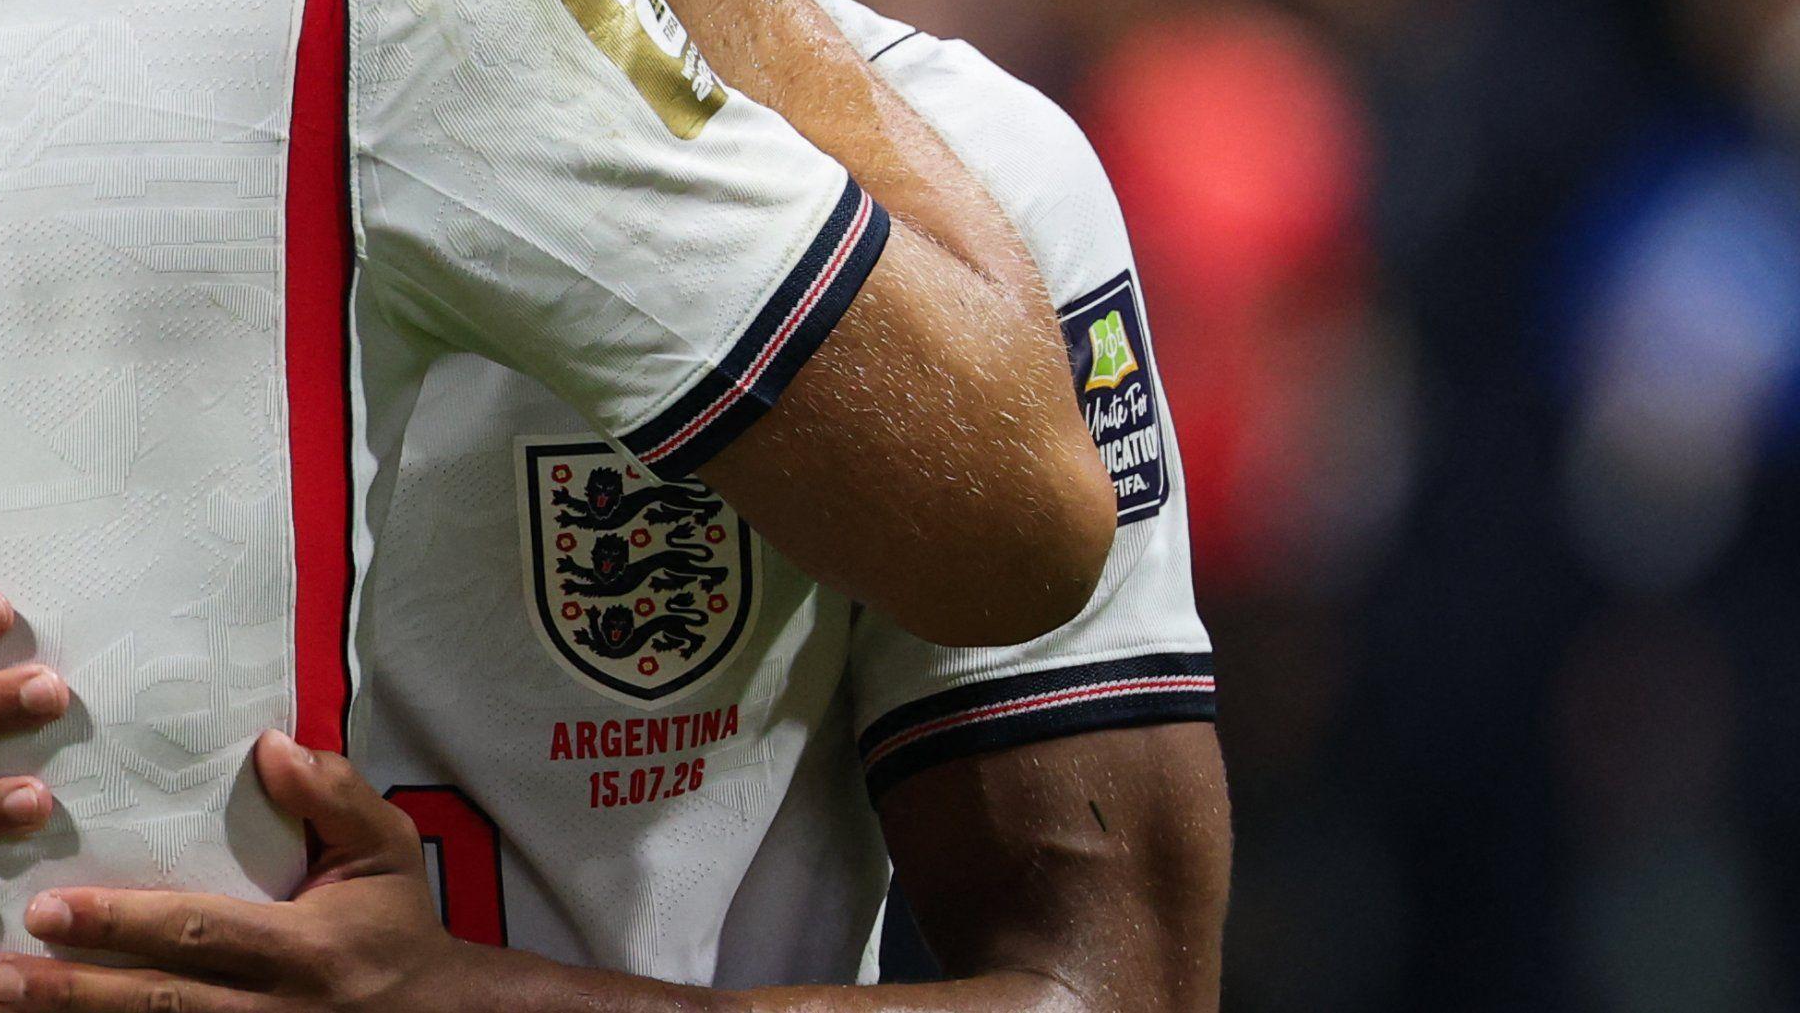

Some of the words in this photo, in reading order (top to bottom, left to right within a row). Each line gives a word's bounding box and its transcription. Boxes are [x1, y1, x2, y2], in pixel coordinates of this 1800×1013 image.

[1085, 394, 1127, 441] Unite
[1125, 382, 1148, 425] For
[1100, 424, 1159, 475] UCATIO
[550, 704, 739, 761] ARGENTINA
[589, 757, 706, 809] 15.07.26
